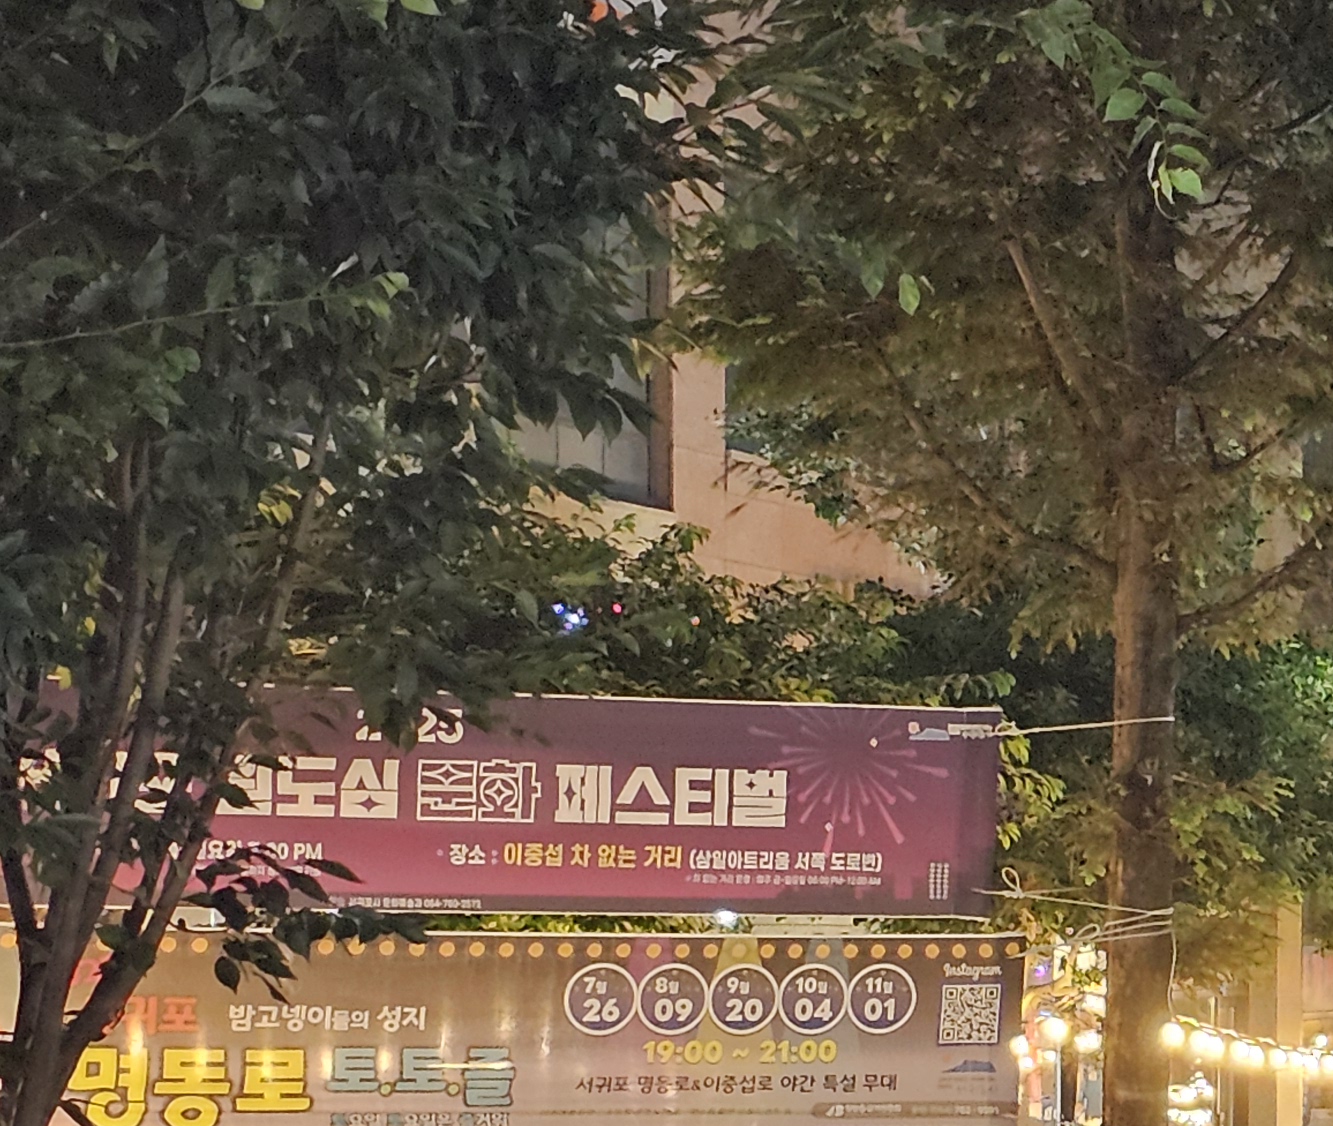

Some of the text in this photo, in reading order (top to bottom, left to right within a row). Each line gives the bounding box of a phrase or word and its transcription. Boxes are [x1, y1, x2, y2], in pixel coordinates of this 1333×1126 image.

[416, 758, 542, 824] 문화
[553, 763, 789, 828] 페스티벌
[293, 842, 323, 860] PM
[449, 843, 486, 865] 장소
[504, 842, 563, 868] 이중섭
[570, 843, 592, 868] 차
[597, 844, 637, 869] 없는
[644, 844, 683, 869] 거리
[689, 849, 790, 871] (삼일아트리움
[794, 851, 826, 872] 서쪽
[829, 852, 883, 873] 도로변)
[943, 963, 1003, 981] Instagram
[583, 976, 606, 995] 7월
[654, 976, 680, 995] 8월
[727, 976, 751, 995] 9월
[795, 976, 828, 995] 10월
[865, 976, 894, 995] 11월
[103, 995, 199, 1035] 귀포
[229, 1004, 427, 1032] 밤고넹이들의 성지
[582, 999, 620, 1022] 26
[655, 999, 693, 1022] 09
[725, 999, 764, 1022] 20
[794, 999, 833, 1022] 04
[864, 999, 896, 1022] 01
[643, 1040, 723, 1064] 19:00
[759, 1040, 838, 1064] 21:00
[575, 1076, 630, 1094] 서귀포
[780, 1075, 816, 1093] 야간
[823, 1074, 857, 1093] 특설
[863, 1073, 898, 1092] 무대
